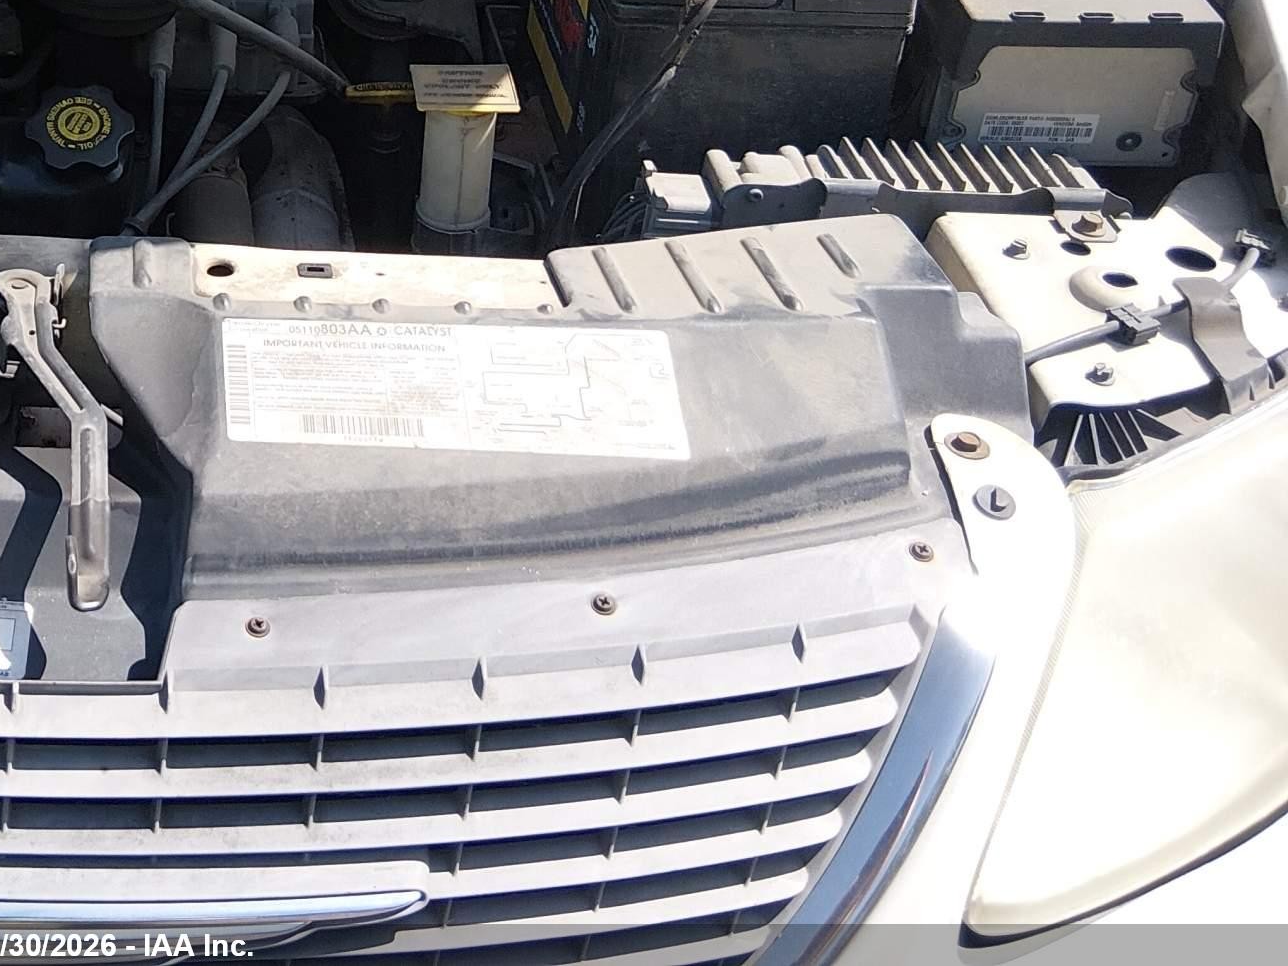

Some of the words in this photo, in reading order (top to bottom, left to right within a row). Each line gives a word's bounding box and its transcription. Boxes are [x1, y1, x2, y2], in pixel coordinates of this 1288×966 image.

[98, 107, 111, 135] ENGINE
[79, 141, 94, 150] OIL
[392, 326, 452, 337] CATALYST
[263, 339, 324, 349] IMPORTANT
[325, 341, 367, 350] VEHICLE
[370, 343, 446, 352] INFORMATION
